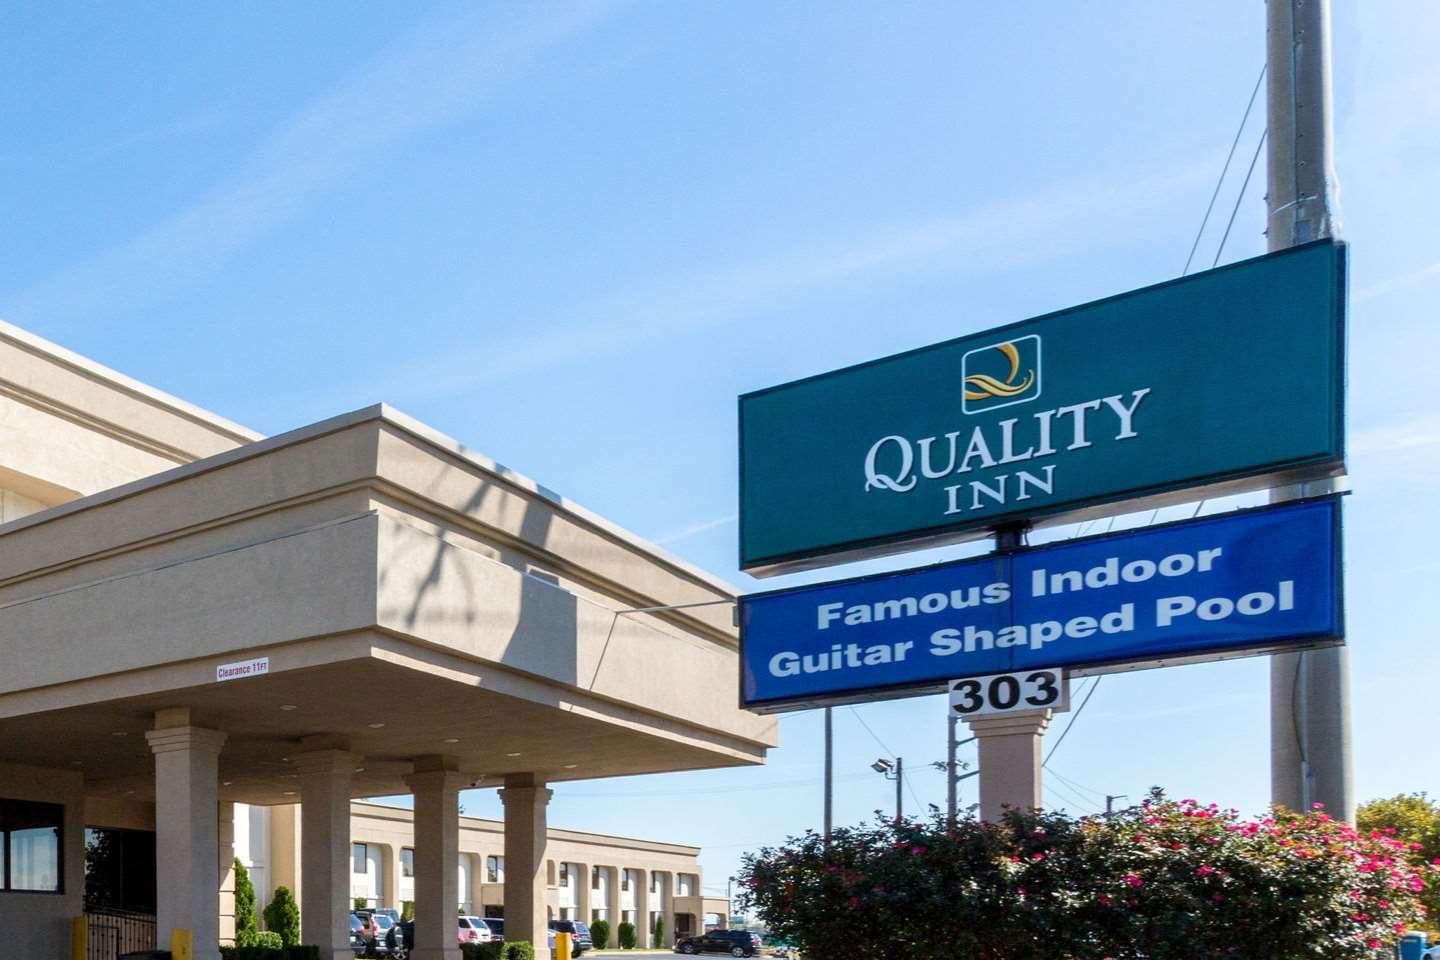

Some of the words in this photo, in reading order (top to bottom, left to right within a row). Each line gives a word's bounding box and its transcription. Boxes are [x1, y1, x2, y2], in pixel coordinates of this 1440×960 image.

[864, 387, 1151, 493] QUALITY
[944, 464, 1057, 515] INN
[817, 581, 1011, 630] Famous
[1031, 547, 1223, 597] Indoor
[768, 640, 914, 678] Guitar
[929, 602, 1135, 656] Shaped
[1156, 580, 1294, 627] Pool
[218, 665, 251, 678] Clearance
[952, 671, 1059, 714] 303
